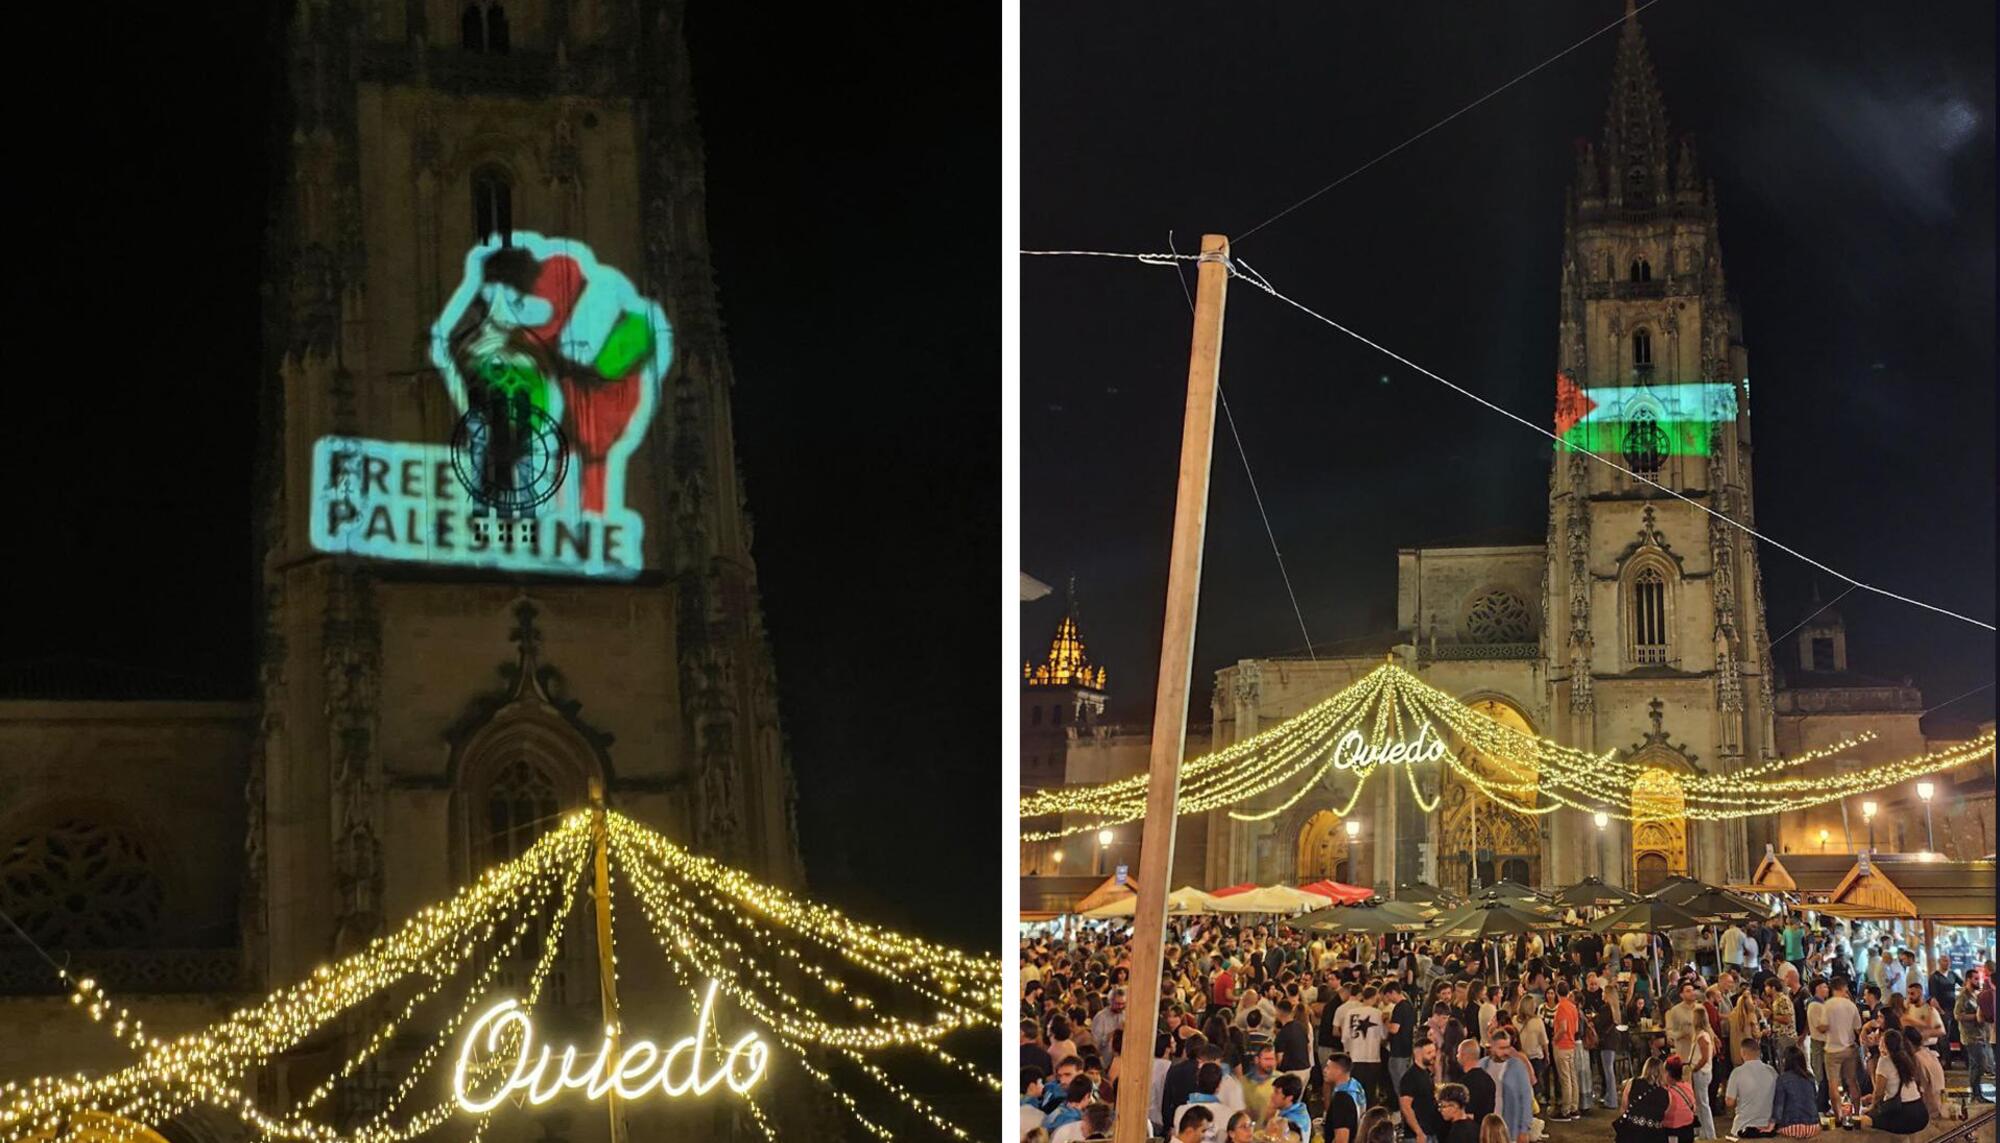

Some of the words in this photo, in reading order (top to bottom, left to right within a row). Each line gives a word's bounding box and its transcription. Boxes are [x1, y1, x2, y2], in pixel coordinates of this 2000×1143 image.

[329, 451, 454, 500] FREE
[1334, 721, 1445, 770] Oviedo
[454, 978, 768, 1113] Oviedo
